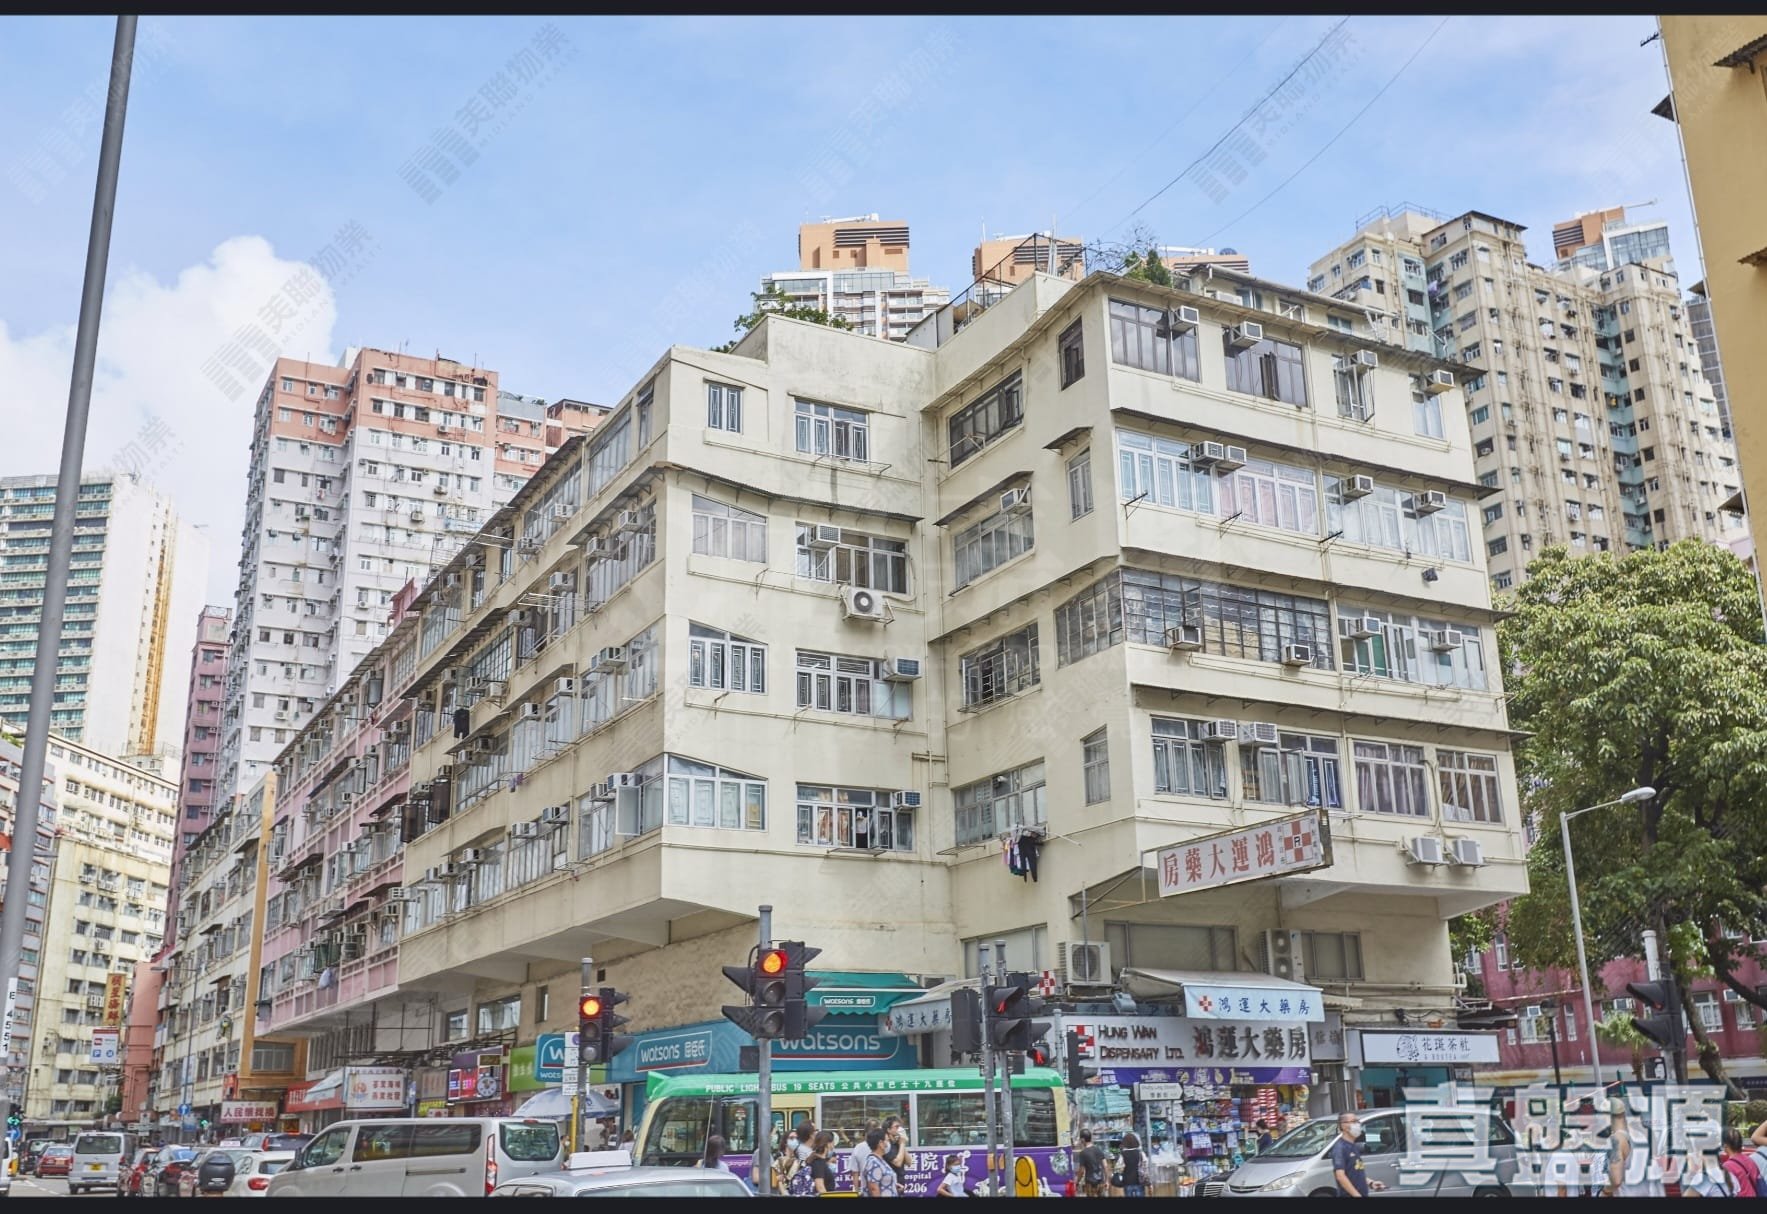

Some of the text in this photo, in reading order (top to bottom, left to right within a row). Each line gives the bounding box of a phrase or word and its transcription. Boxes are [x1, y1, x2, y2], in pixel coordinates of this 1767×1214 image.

[1218, 997, 1311, 1015] 鴻運大藥房
[1098, 1025, 1158, 1040] HUNG WAN
[780, 1032, 881, 1051] watsons
[1193, 1024, 1307, 1060] 鴻運大藥房
[640, 1044, 680, 1063] watsons
[1100, 1045, 1159, 1060] DISPENSARY
[540, 1071, 563, 1080] wats
[705, 1084, 735, 1093] PUBLIC
[740, 1084, 760, 1092] LIGH
[771, 1083, 787, 1092] BUS
[793, 1083, 802, 1091] 19
[808, 1082, 836, 1091] SEATS
[903, 1172, 932, 1181] ospital
